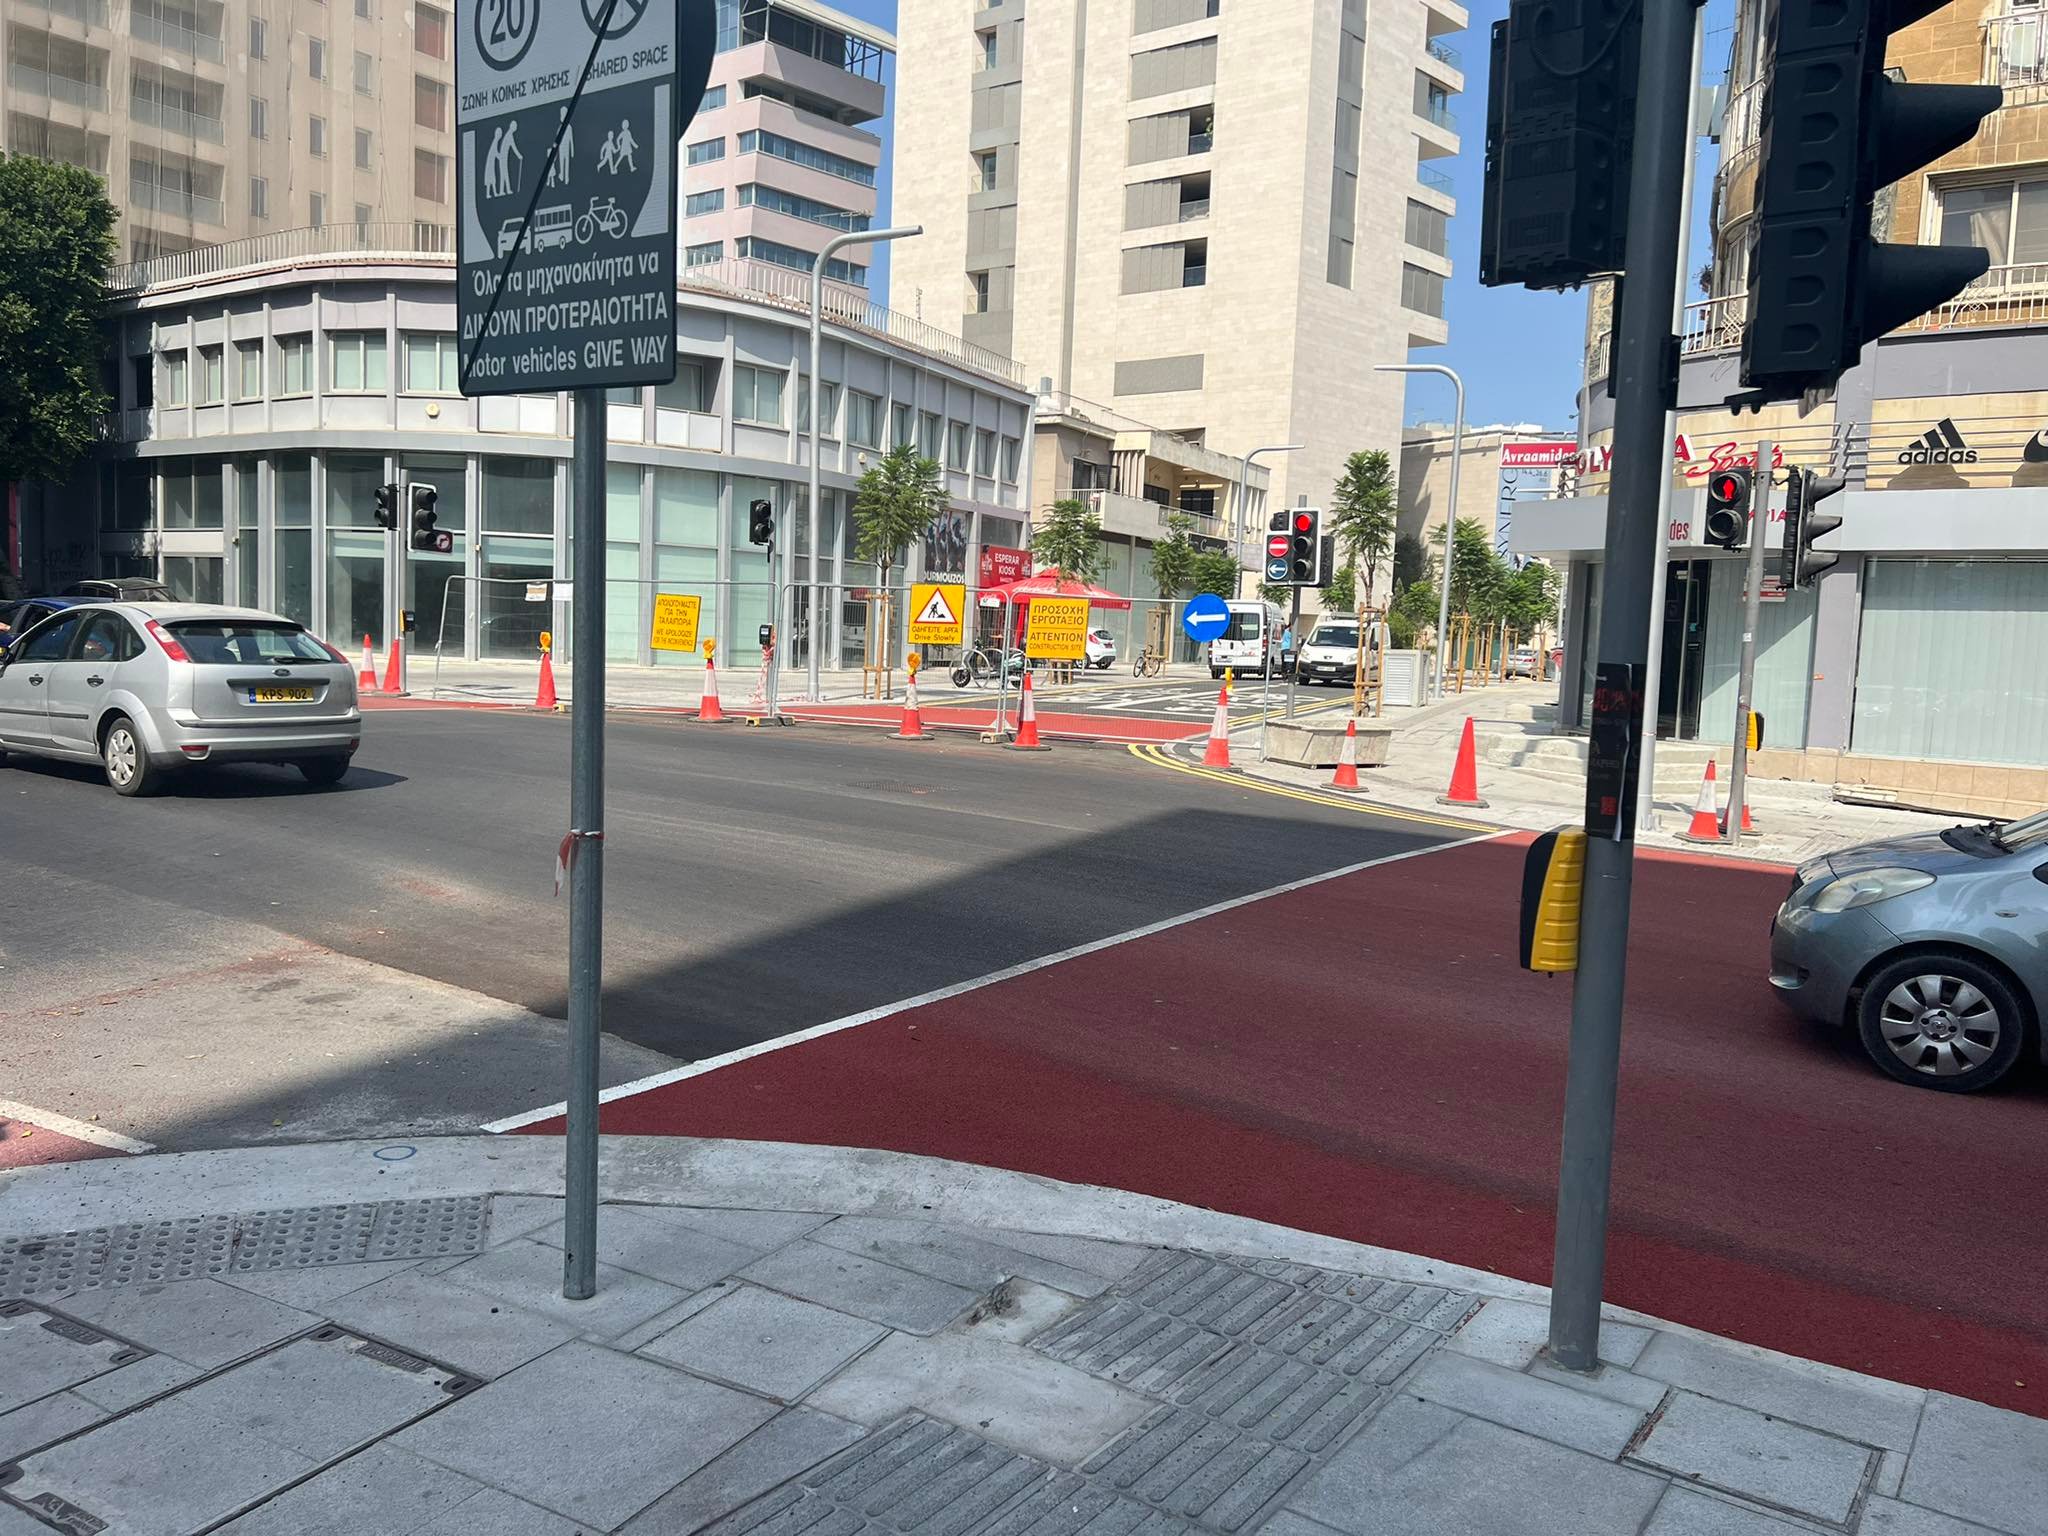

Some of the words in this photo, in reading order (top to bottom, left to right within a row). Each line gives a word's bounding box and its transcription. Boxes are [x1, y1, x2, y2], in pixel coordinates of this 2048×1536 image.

[489, 0, 525, 46] 20
[462, 94, 489, 112] ΖΩΝΗ
[491, 80, 527, 105] ΚΟΙΝΗΣ
[531, 69, 570, 95] ΧΡΗΣΗΣ
[586, 55, 628, 82] SHARED
[632, 44, 669, 70] SPACE
[527, 251, 633, 297] μηχανοκίνητα
[639, 251, 659, 275] να
[525, 291, 668, 334] ΠΡΟΤΕΡΑΙΟΤΗΤΑ
[463, 352, 507, 379] Motor
[512, 345, 577, 375] vehicles
[583, 338, 624, 370] GIVE
[630, 333, 668, 366] WAY
[1685, 441, 1784, 478] Spors
[1899, 446, 1978, 465] adidas
[994, 552, 1020, 566] ESPERAR
[998, 565, 1016, 576] KIOSK
[1034, 605, 1084, 615] ΠΡΟΣΟΧΗ
[1031, 615, 1084, 625] ΕΡΓΟΤΑΞΙΟ
[914, 633, 932, 641] Drive
[933, 633, 955, 642] Slowly
[1030, 632, 1084, 642] ATTENTION
[262, 689, 284, 700] KPS
[288, 689, 308, 700] 902
